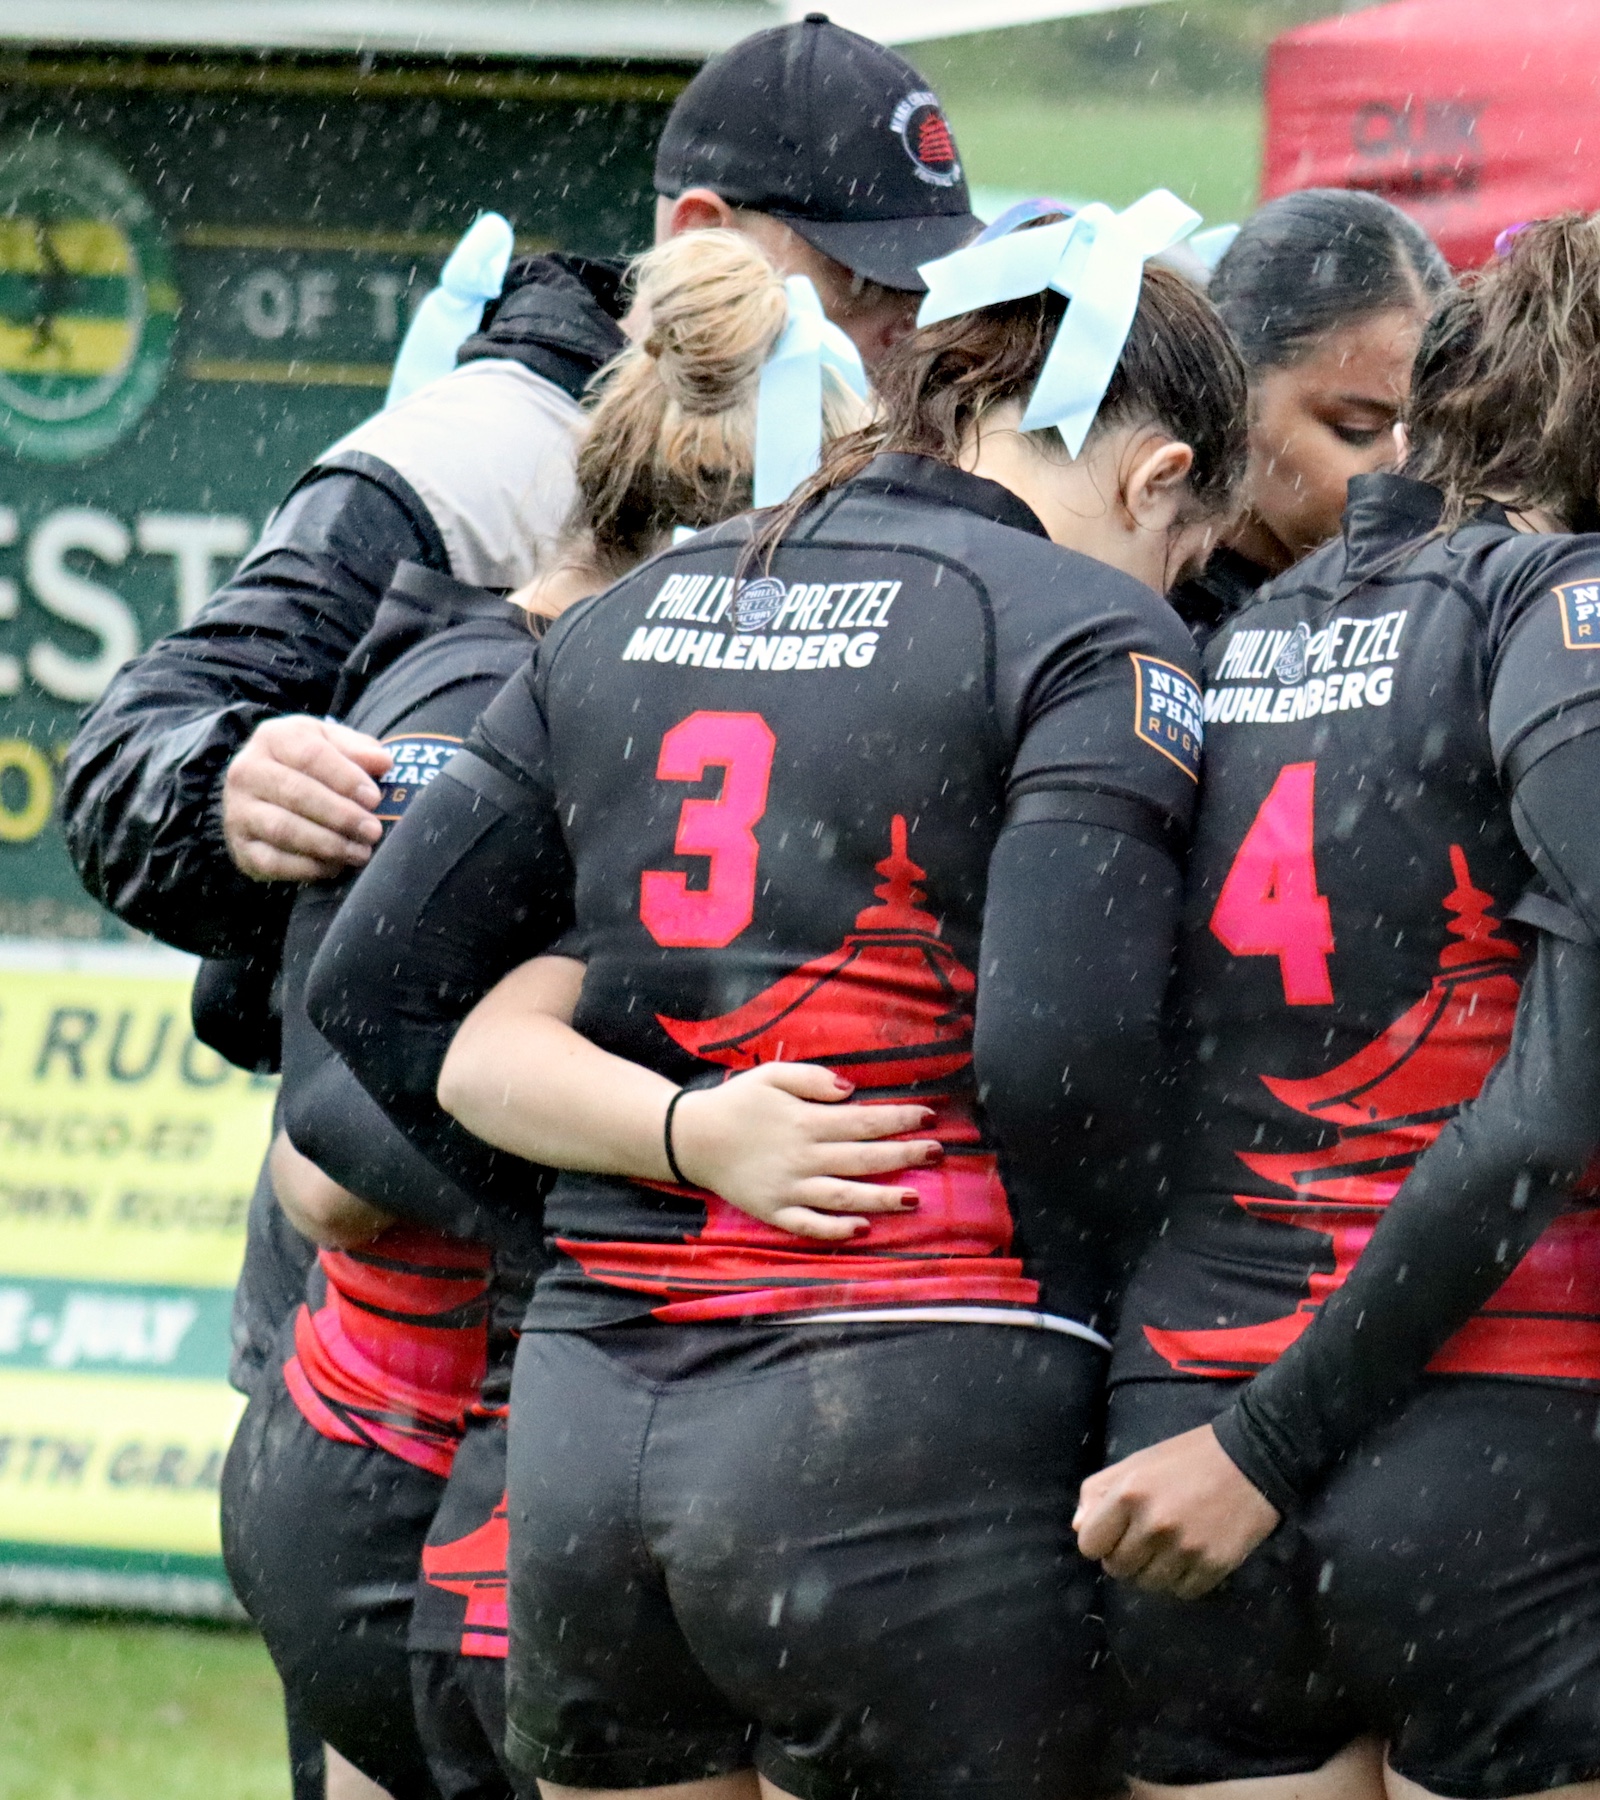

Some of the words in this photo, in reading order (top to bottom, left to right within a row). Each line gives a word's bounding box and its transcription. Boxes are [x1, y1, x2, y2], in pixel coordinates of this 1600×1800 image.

[240, 268, 340, 340] OF
[0, 504, 250, 702] ST
[645, 573, 747, 624] PHILLY
[771, 580, 902, 631] PRETZEL
[621, 625, 880, 671] MUHLENBERG
[1215, 629, 1293, 681] PHILLY
[639, 710, 777, 948] 3
[1208, 761, 1336, 1006] 4
